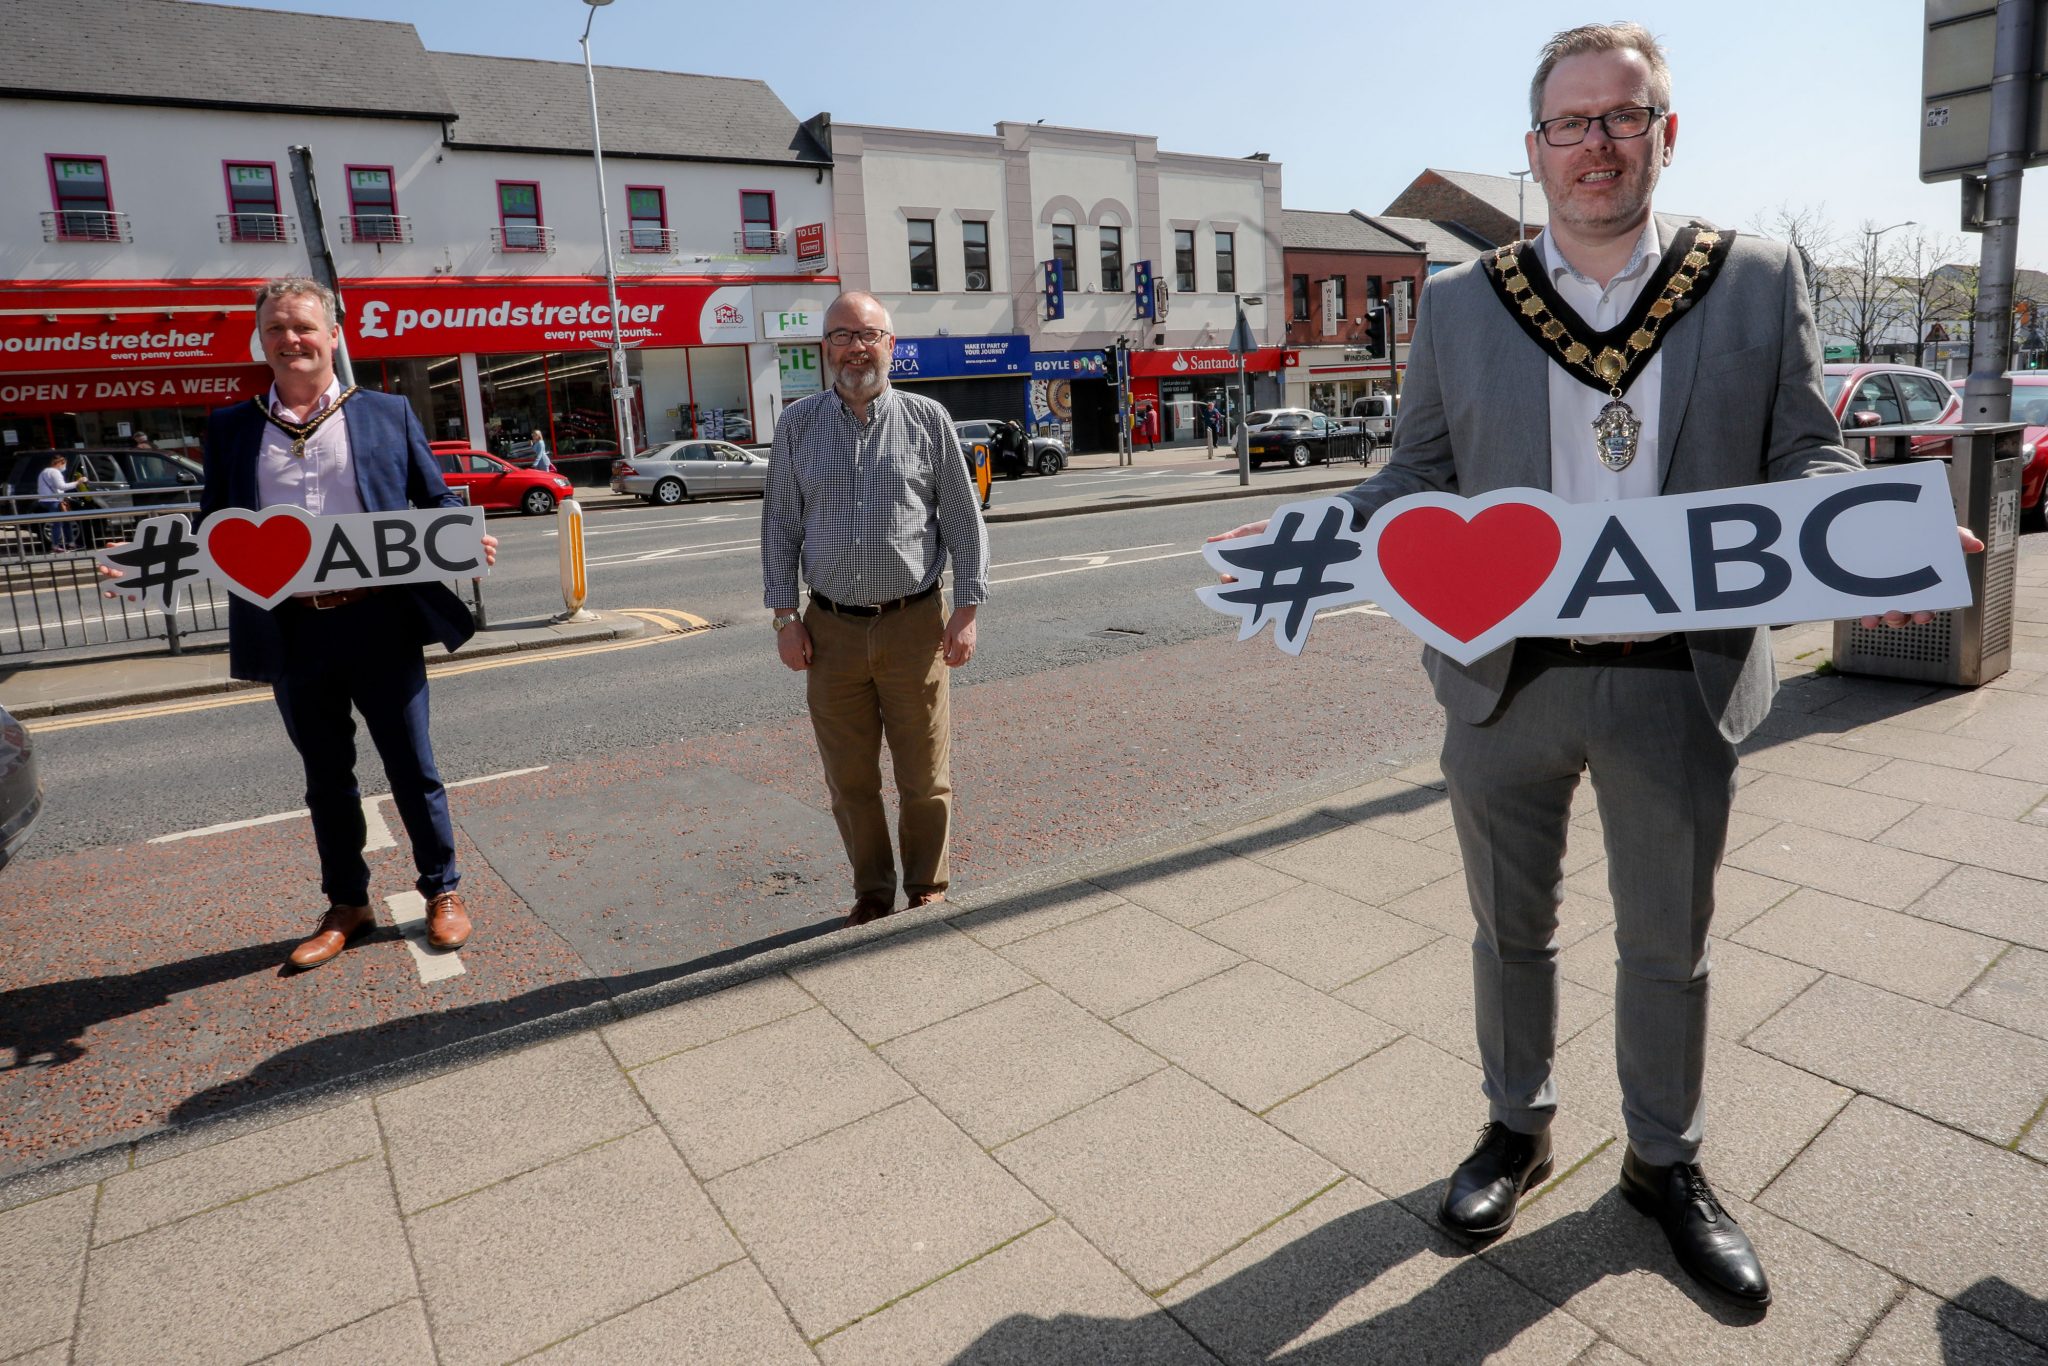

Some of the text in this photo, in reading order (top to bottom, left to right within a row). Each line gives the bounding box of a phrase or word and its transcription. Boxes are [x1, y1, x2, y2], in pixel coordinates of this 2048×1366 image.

[797, 226, 821, 237] TO LET
[394, 300, 665, 336] poundstretcher
[720, 308, 736, 316] Pet
[544, 331, 576, 341] every
[579, 329, 614, 341] penny
[111, 352, 138, 361] every
[141, 351, 171, 360] penny
[1344, 354, 1371, 362] WINDSO
[889, 358, 920, 372] SPCA
[1034, 360, 1070, 371] BOYLE
[1, 377, 241, 402] OPEN 7 DAYS A WEEK
[313, 514, 480, 583] ABC
[1556, 481, 1943, 620] ABC
